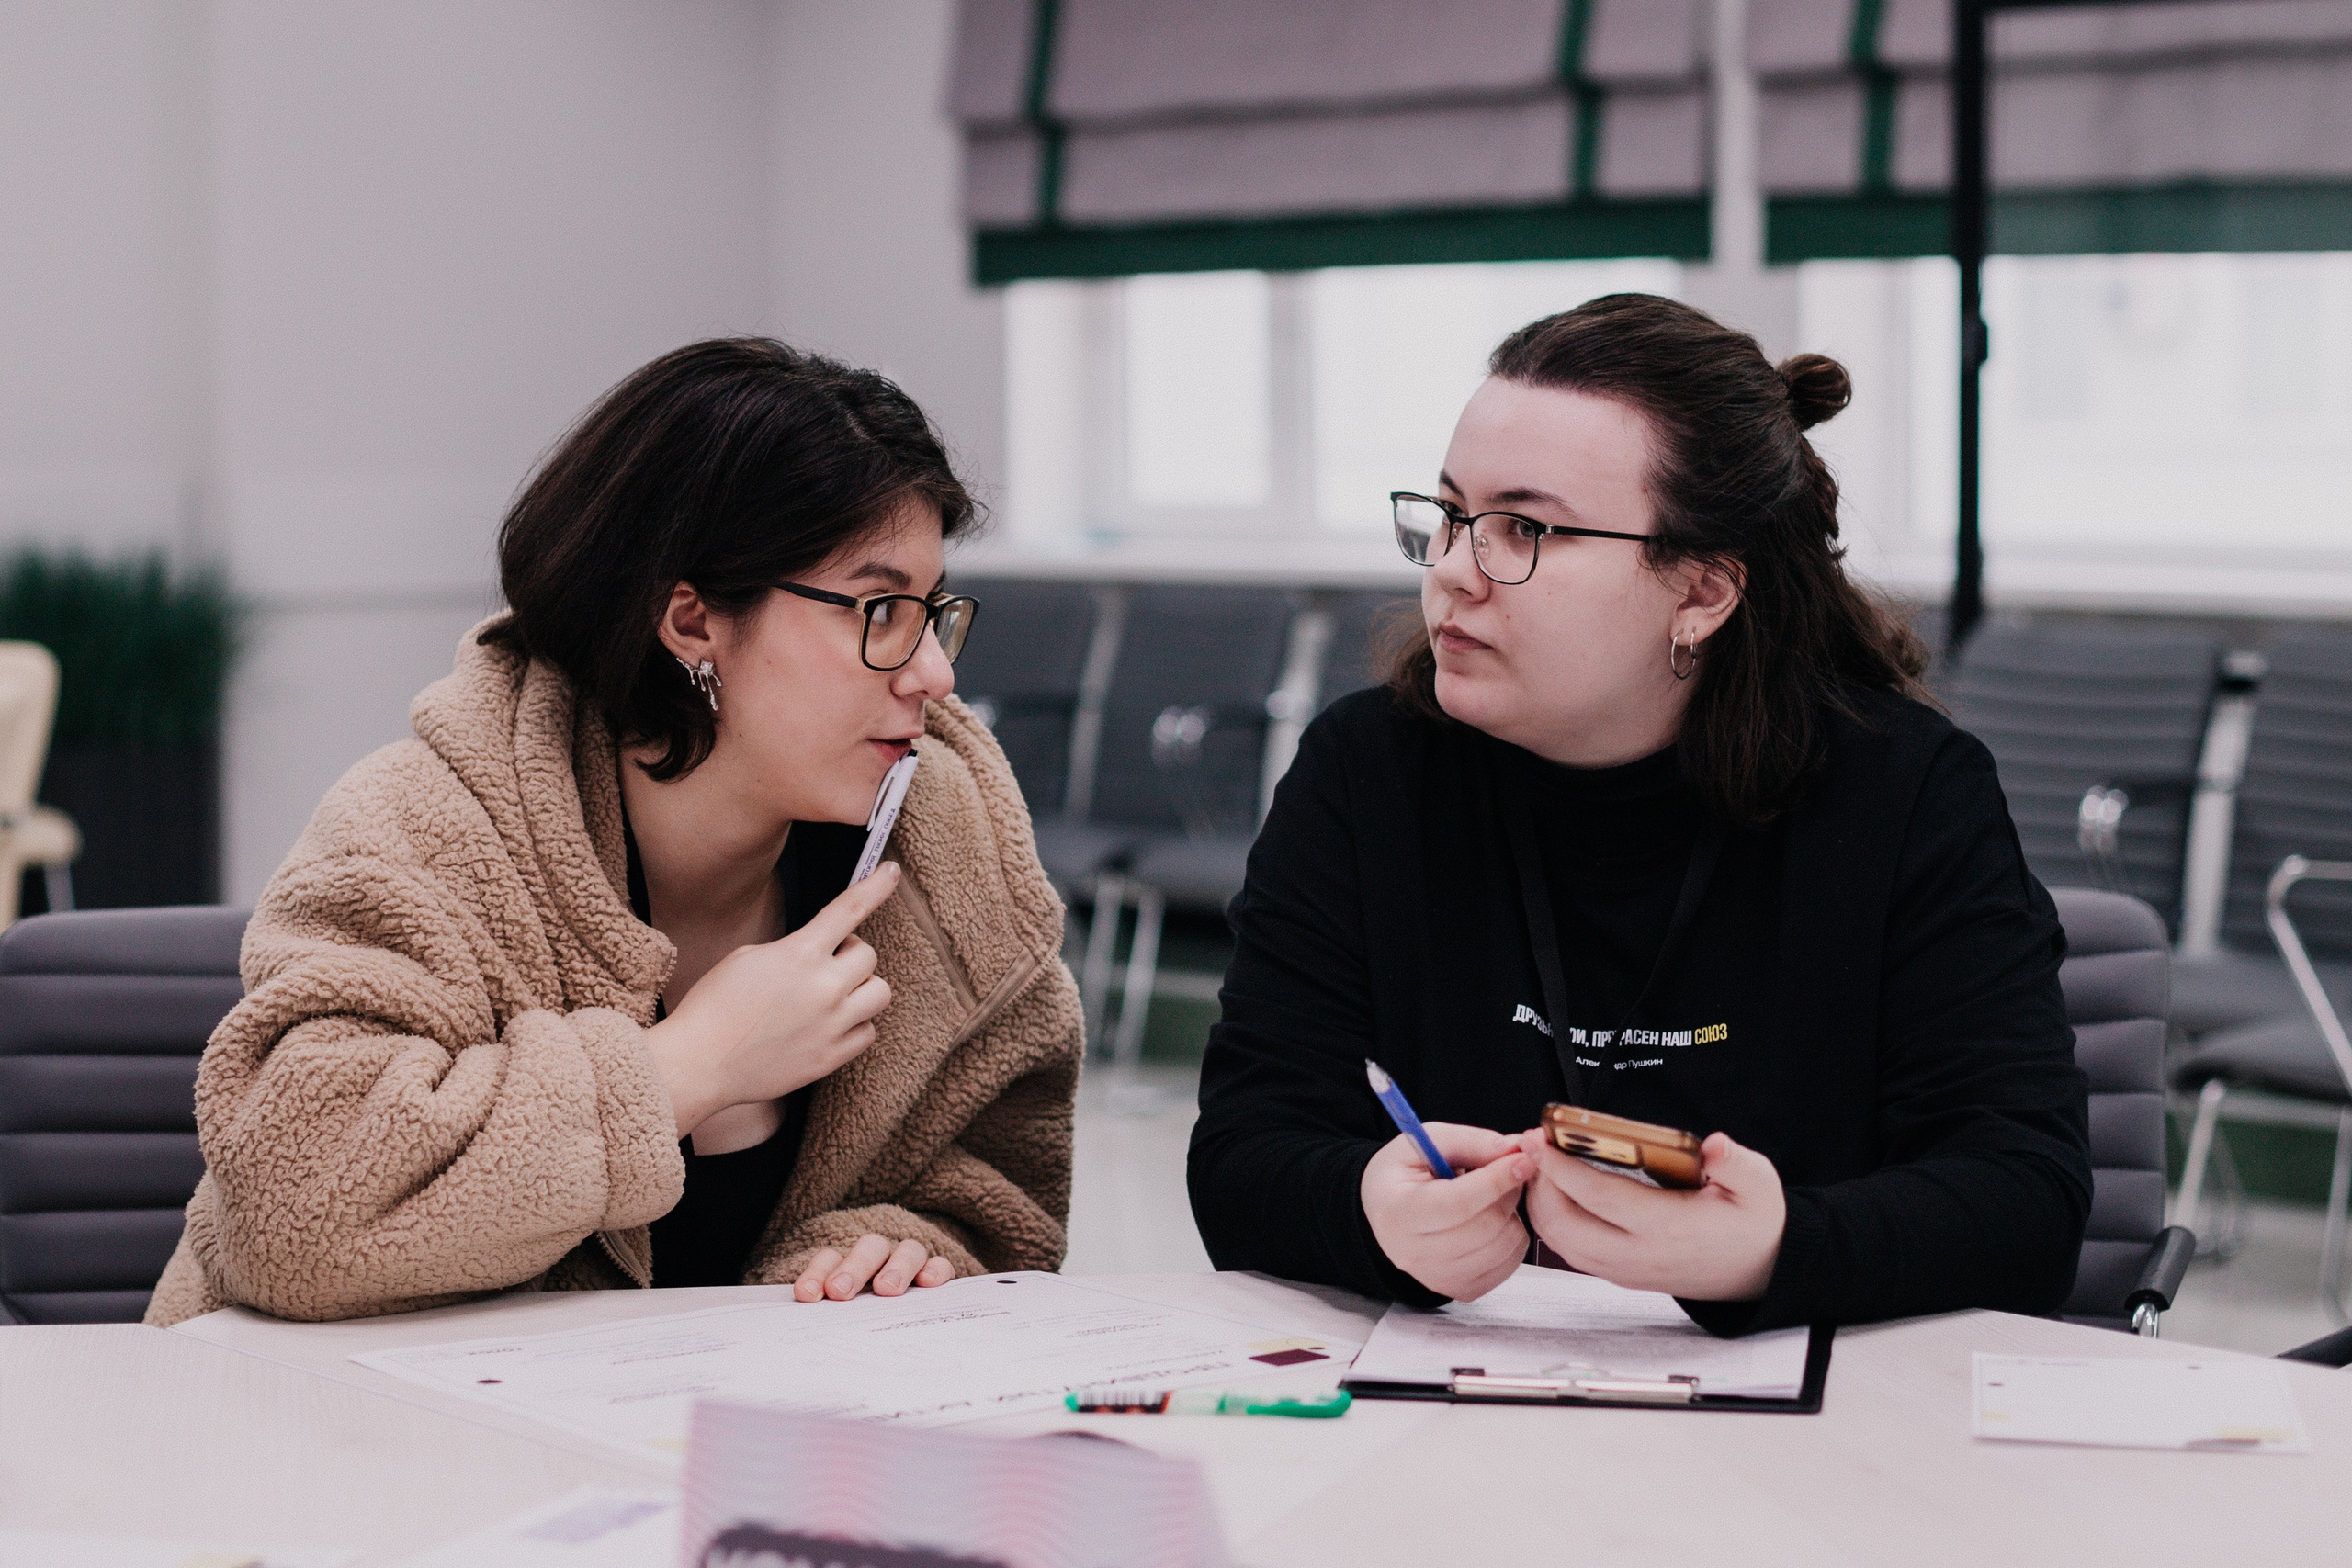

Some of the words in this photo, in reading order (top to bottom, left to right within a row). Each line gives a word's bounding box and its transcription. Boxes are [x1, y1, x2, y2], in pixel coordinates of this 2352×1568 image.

[1661, 1030, 1692, 1046] НАШ
[1694, 1022, 1728, 1045] СОЮЗ
[1575, 1056, 1627, 1070] Алекдр
[1628, 1058, 1664, 1069] Пушкин
